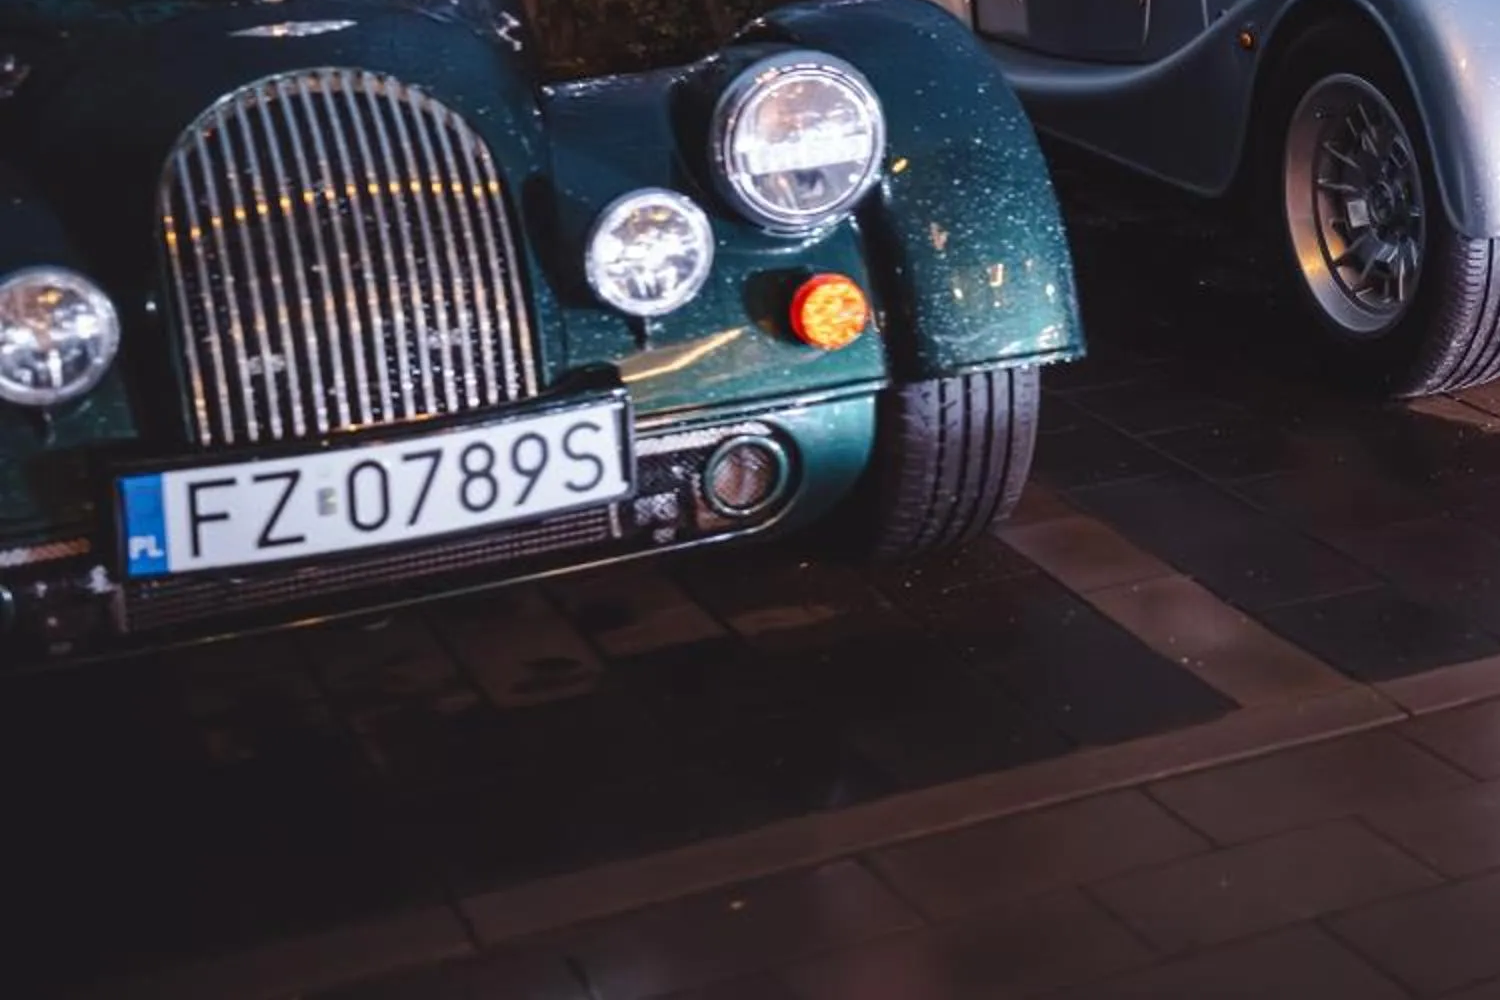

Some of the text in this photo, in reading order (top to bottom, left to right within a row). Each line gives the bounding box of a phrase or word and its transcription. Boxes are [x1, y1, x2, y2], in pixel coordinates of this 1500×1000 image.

[187, 421, 604, 558] FZ 0789S
[129, 533, 163, 559] PL
